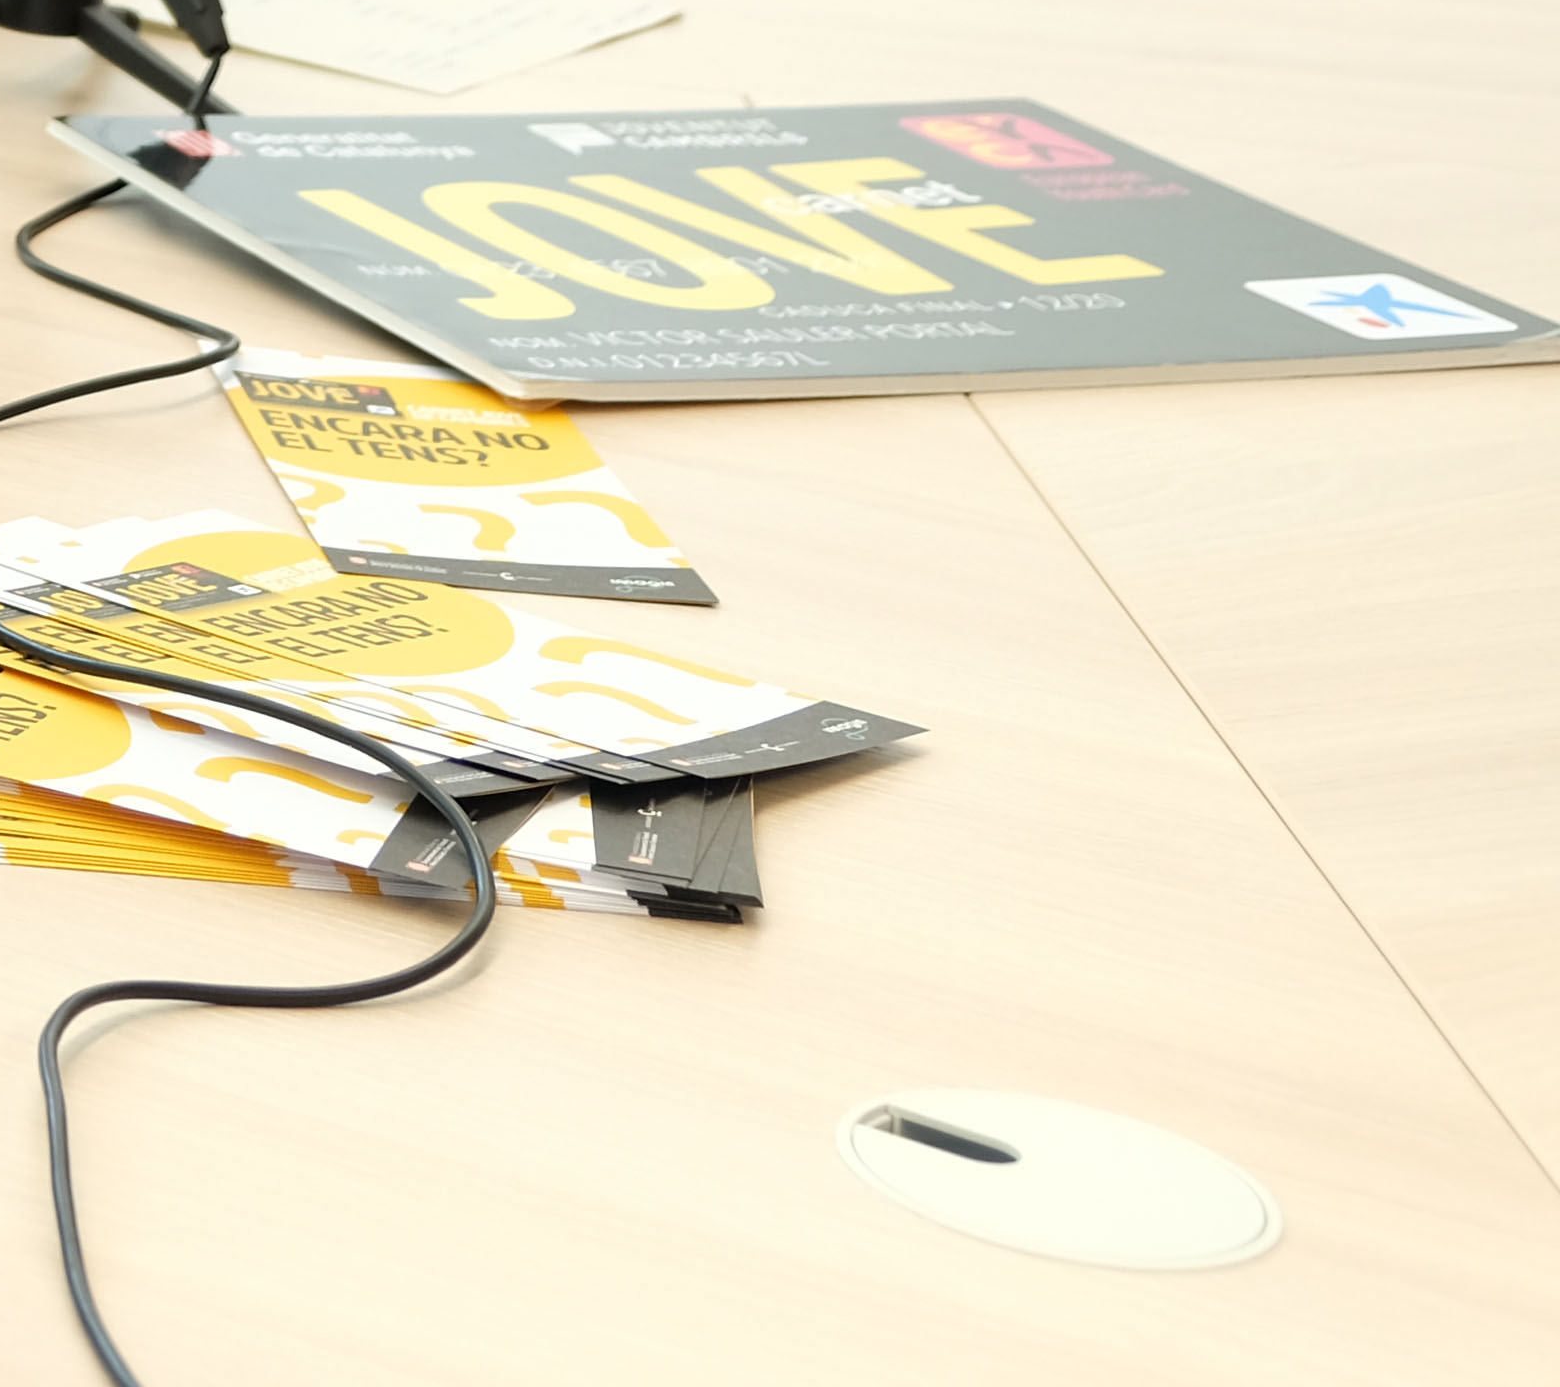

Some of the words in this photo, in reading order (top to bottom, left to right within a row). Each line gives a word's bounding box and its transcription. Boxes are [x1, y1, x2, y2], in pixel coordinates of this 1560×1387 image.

[764, 180, 982, 215] carnet
[298, 156, 1166, 320] JOVE
[566, 329, 721, 346] VICTOR
[250, 377, 361, 405] JOVE
[259, 408, 467, 446] ENCARA
[472, 429, 551, 452] NO
[271, 429, 333, 453] EL
[338, 436, 491, 468] TENS?
[115, 573, 218, 605] JOVE
[200, 595, 379, 637] ENCARA
[342, 581, 429, 610] NO
[190, 644, 273, 664] EL
[264, 636, 348, 658] EL
[309, 614, 450, 648] TENS?
